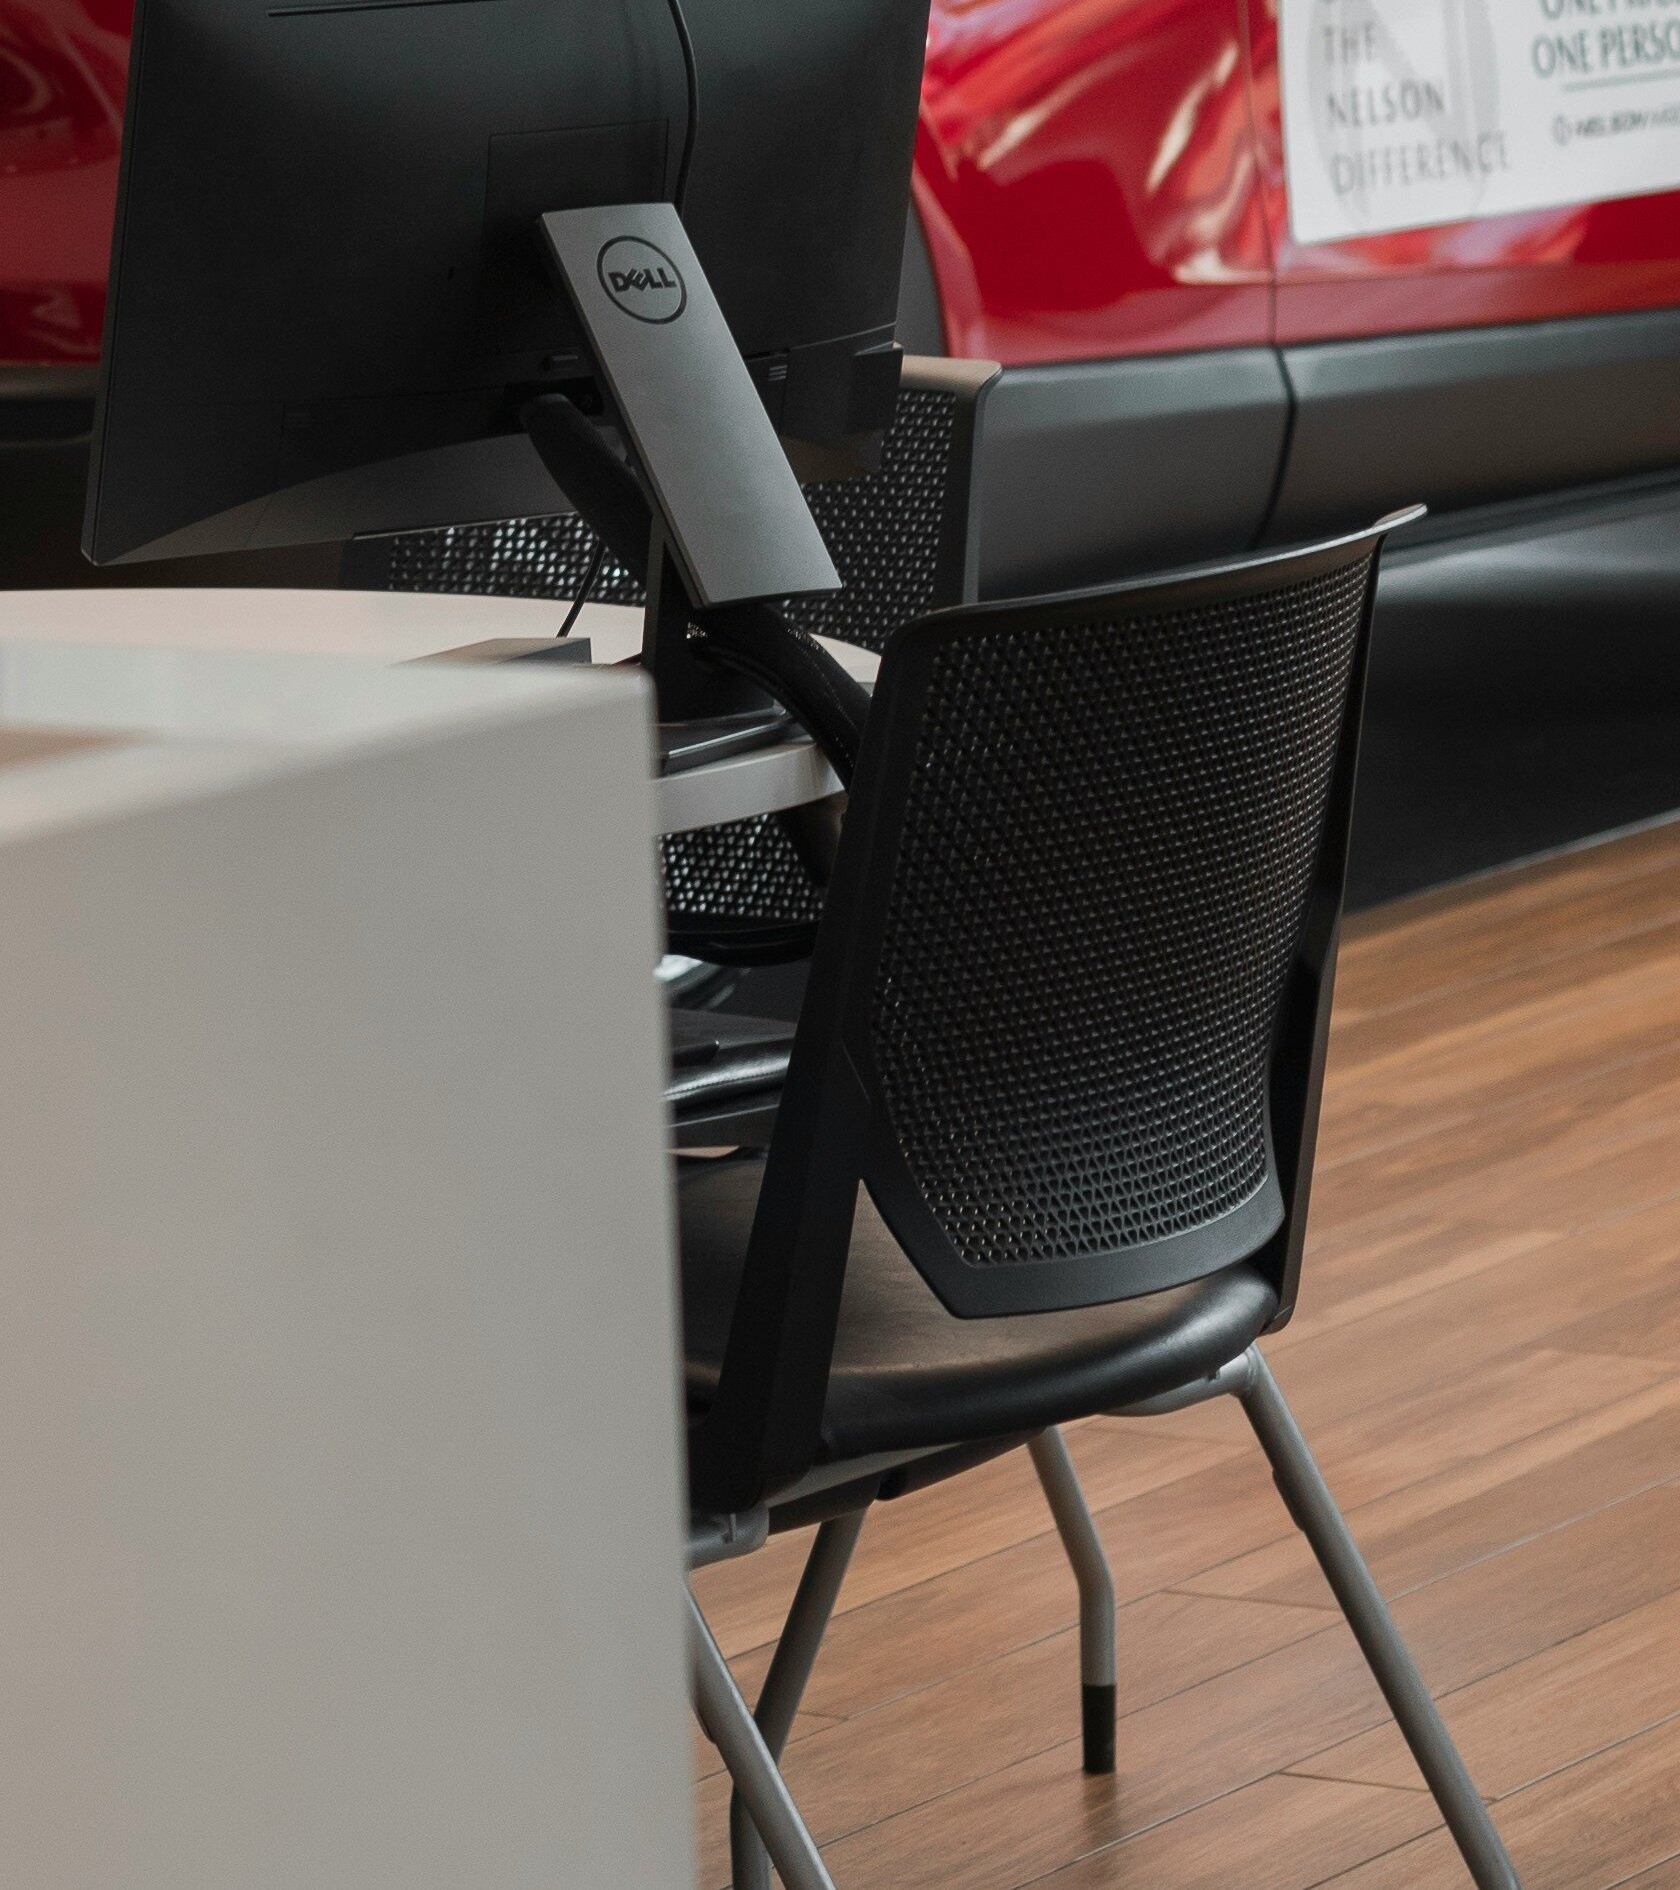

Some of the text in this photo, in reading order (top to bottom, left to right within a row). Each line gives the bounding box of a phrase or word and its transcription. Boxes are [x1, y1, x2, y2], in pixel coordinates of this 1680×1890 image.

[1322, 20, 1377, 65] THE
[1530, 28, 1592, 78] ONE
[1327, 78, 1445, 130] NELSON
[1330, 129, 1509, 196] DIFFERENCE
[608, 267, 677, 293] DELL
